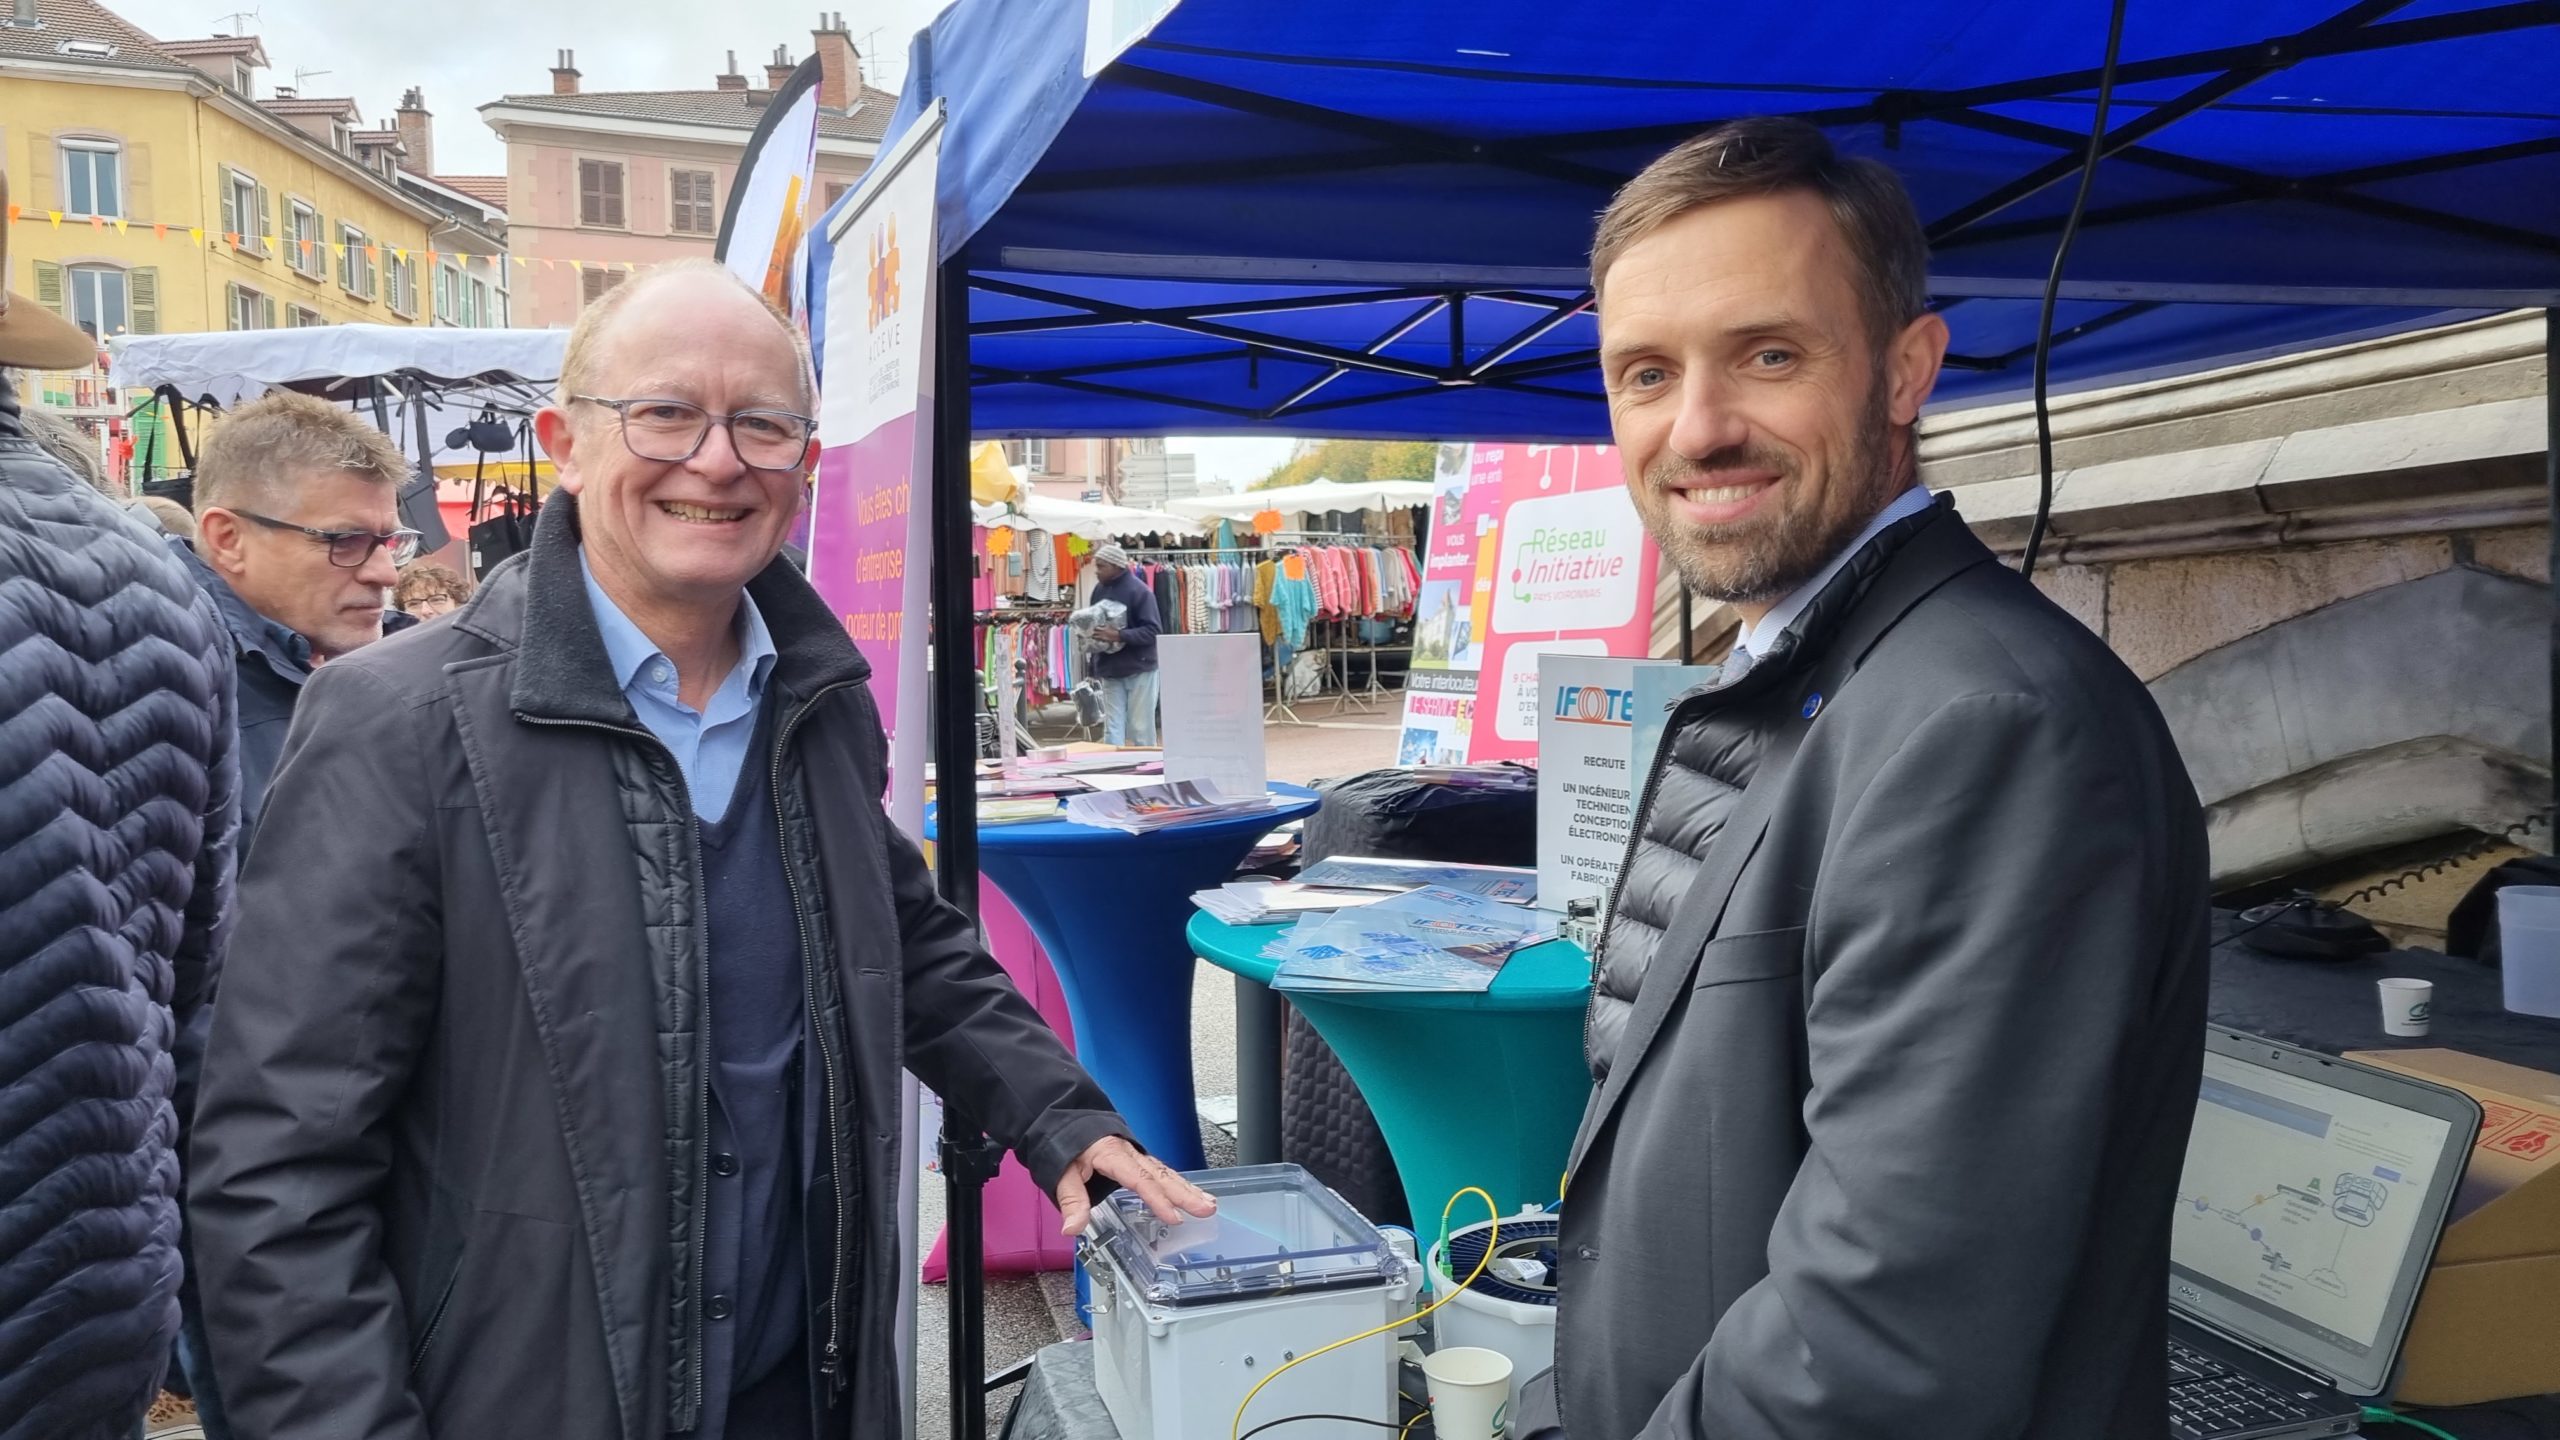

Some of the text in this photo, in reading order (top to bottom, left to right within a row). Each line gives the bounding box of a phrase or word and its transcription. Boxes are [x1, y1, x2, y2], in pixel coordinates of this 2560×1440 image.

[857, 492, 874, 527] Vous
[875, 484, 892, 522] êtes
[1532, 527, 1606, 554] Réseau
[856, 542, 903, 589] d'entreprise
[1527, 552, 1623, 584] Initiative
[1411, 672, 1431, 689] Votre
[1584, 756, 1626, 770] RECRUTE
[1562, 783, 1630, 800] UN INGÉNIEUR
[1561, 854, 1574, 865] UN
[1412, 918, 1500, 933] IFOTEC
